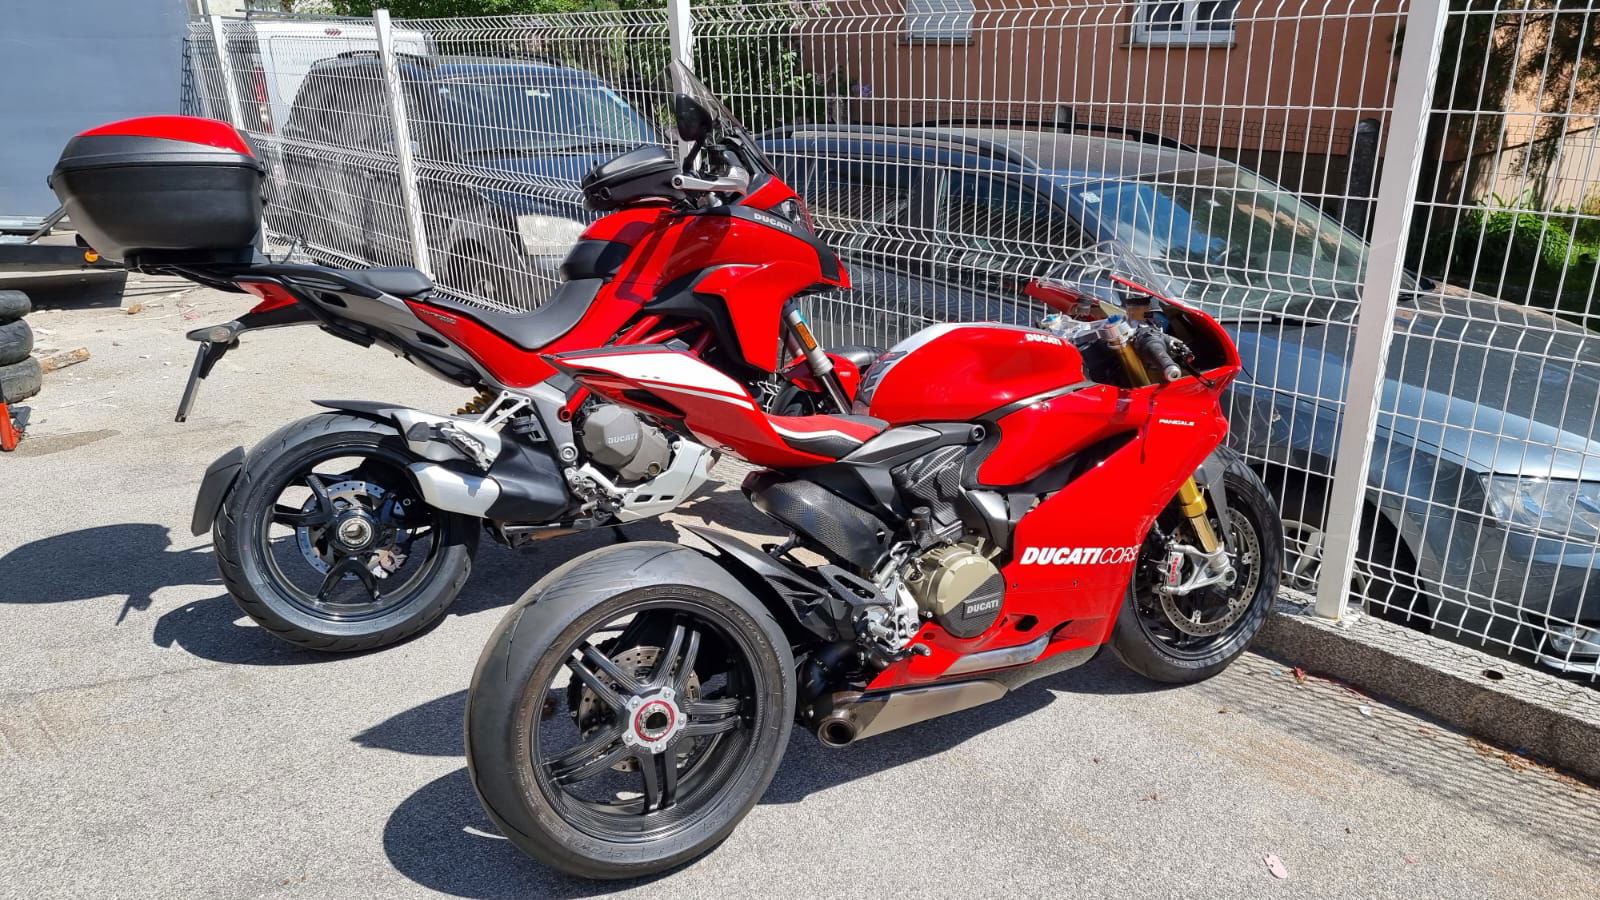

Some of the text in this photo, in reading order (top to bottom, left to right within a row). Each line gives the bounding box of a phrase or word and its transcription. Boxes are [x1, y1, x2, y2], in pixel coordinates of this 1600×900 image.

[754, 213, 792, 232] DUCATI
[1025, 333, 1063, 346] DUCATI
[607, 432, 639, 445] DUCATI
[1020, 547, 1103, 565] DUCATI
[967, 600, 1000, 614] DUCATI
